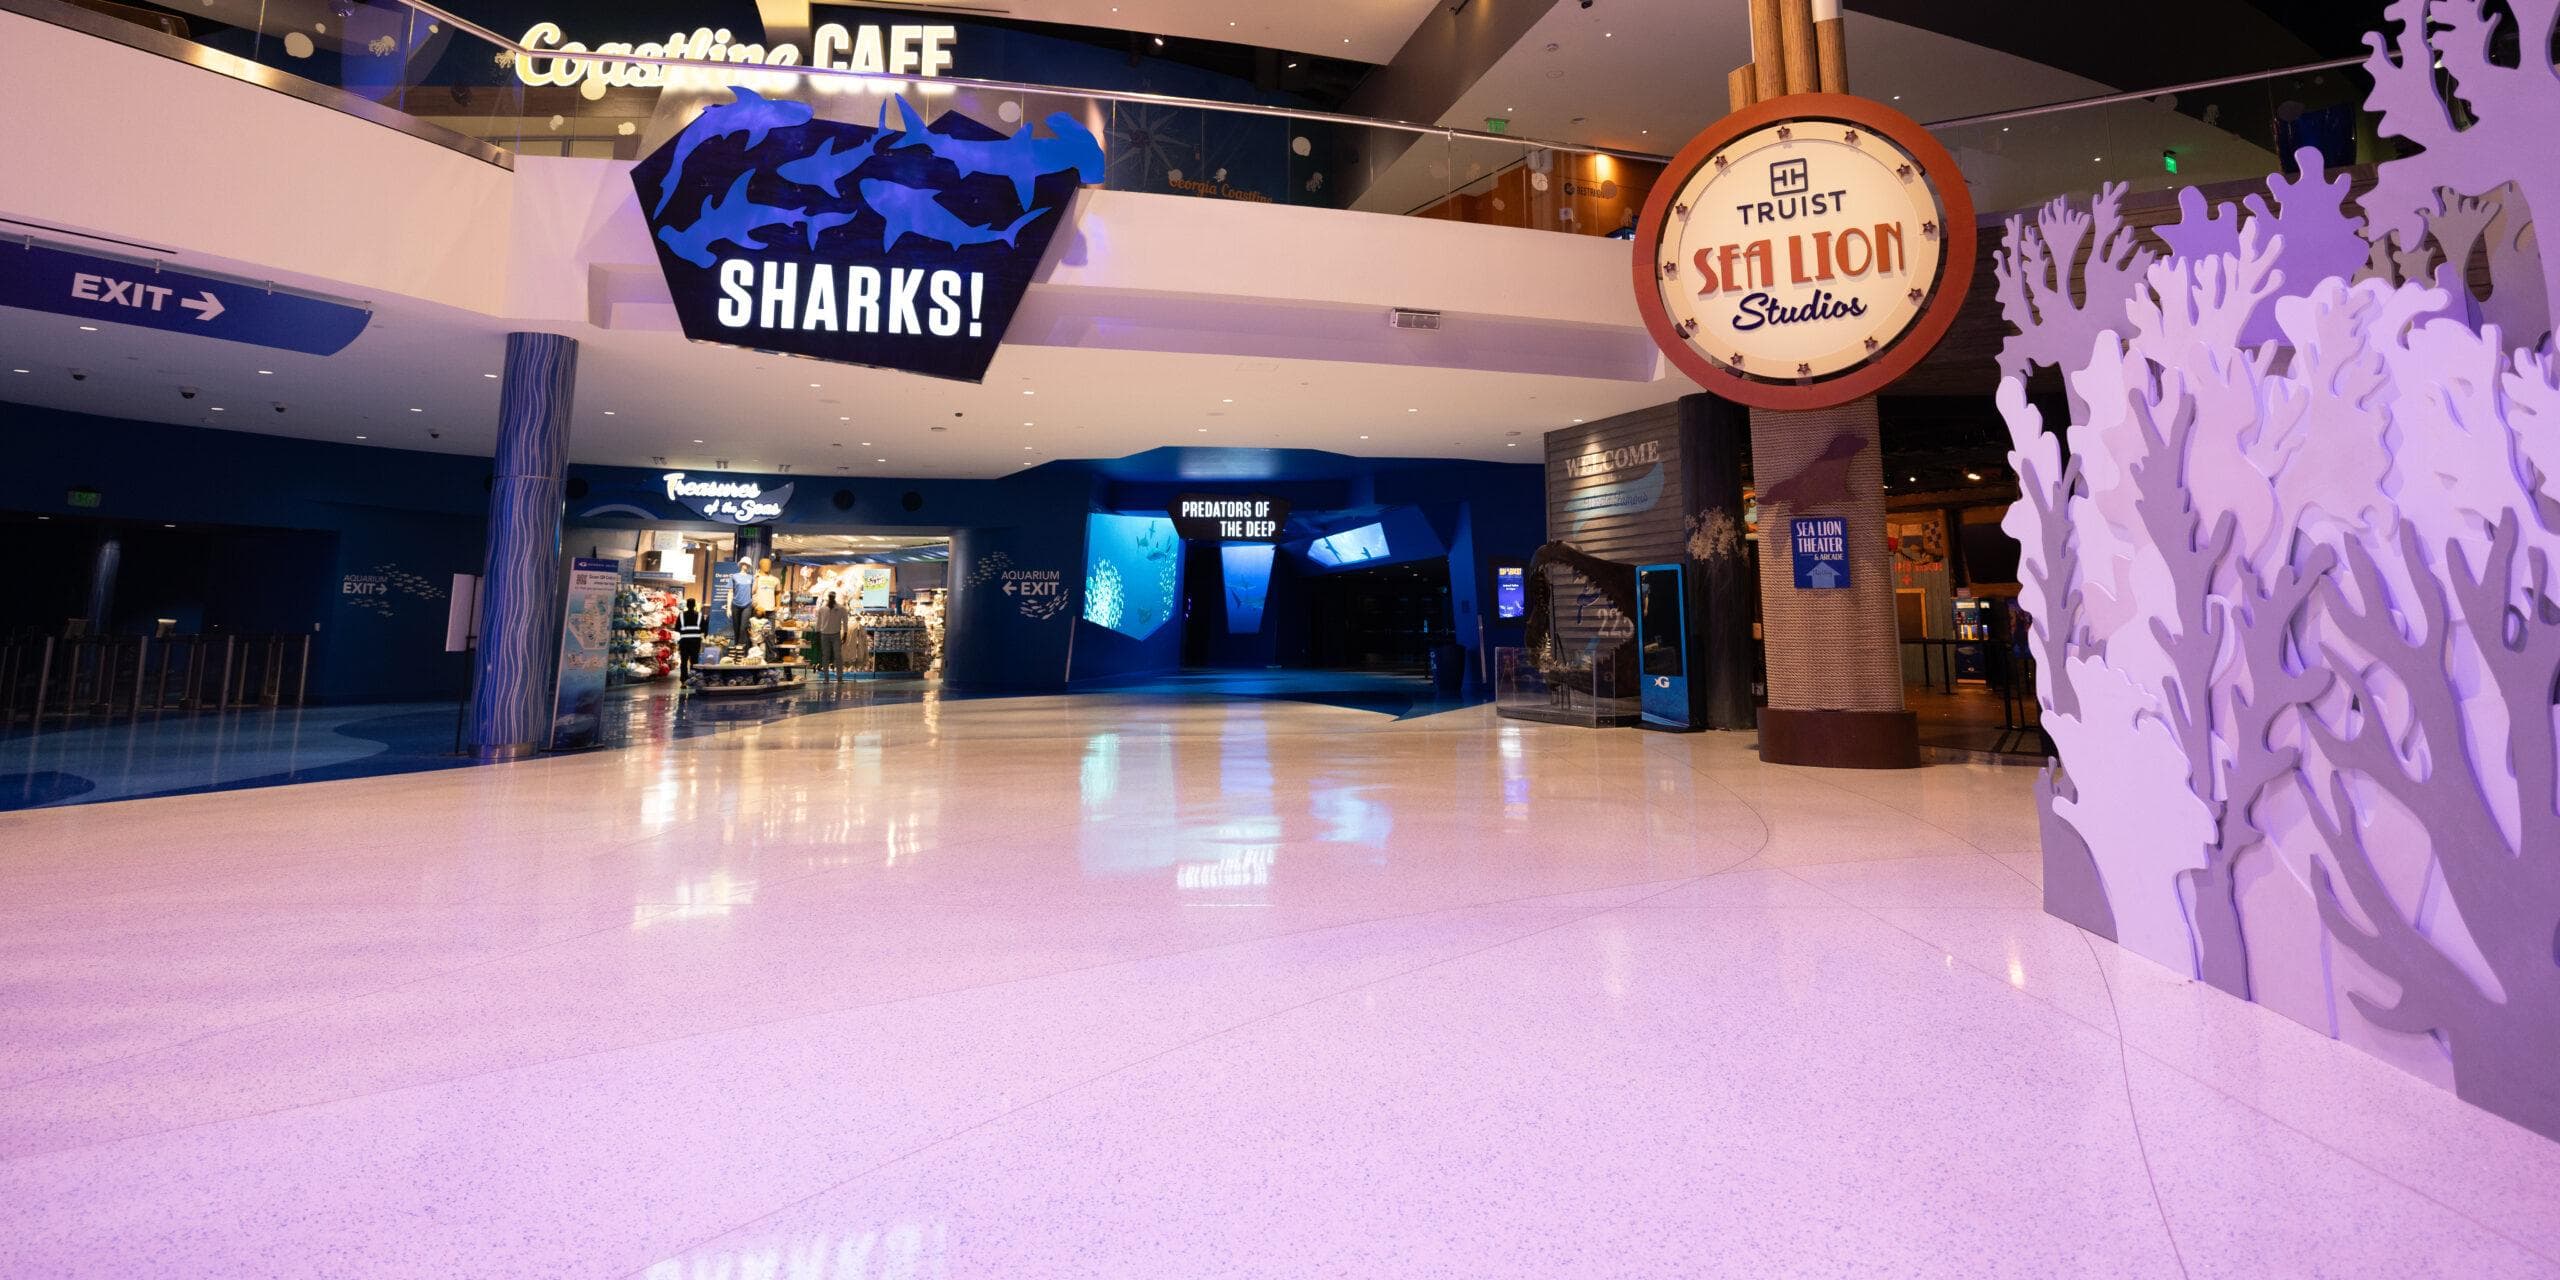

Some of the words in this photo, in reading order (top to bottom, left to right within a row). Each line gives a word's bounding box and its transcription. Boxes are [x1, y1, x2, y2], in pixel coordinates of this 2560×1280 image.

[515, 22, 800, 91] Coastline
[812, 23, 956, 91] CAFE
[1736, 189, 1847, 225] TRUIST
[1693, 238, 1775, 296] SEA
[1788, 221, 1906, 285] LION
[71, 272, 173, 311] EXIT
[718, 258, 984, 338] SHARKS!
[1732, 289, 1868, 331] Studios
[1566, 440, 1660, 478] WELCOME
[663, 473, 762, 501] Treasures
[703, 499, 720, 516] of
[721, 501, 738, 513] the
[735, 500, 782, 521] Seas
[1182, 501, 1252, 518] PREDATORS
[1255, 501, 1270, 518] OF
[1220, 520, 1243, 537] THE
[1246, 520, 1276, 537] DEEP
[1796, 521, 1816, 537] SEA
[1817, 520, 1842, 536] LION
[1797, 537, 1843, 553] THEATER
[1820, 553, 1844, 561] ARCADE
[344, 575, 388, 583] AQUARIUM
[1001, 570, 1060, 580] AQUARIUM
[343, 582, 376, 594] EXIT
[1021, 581, 1059, 596] EXIT
